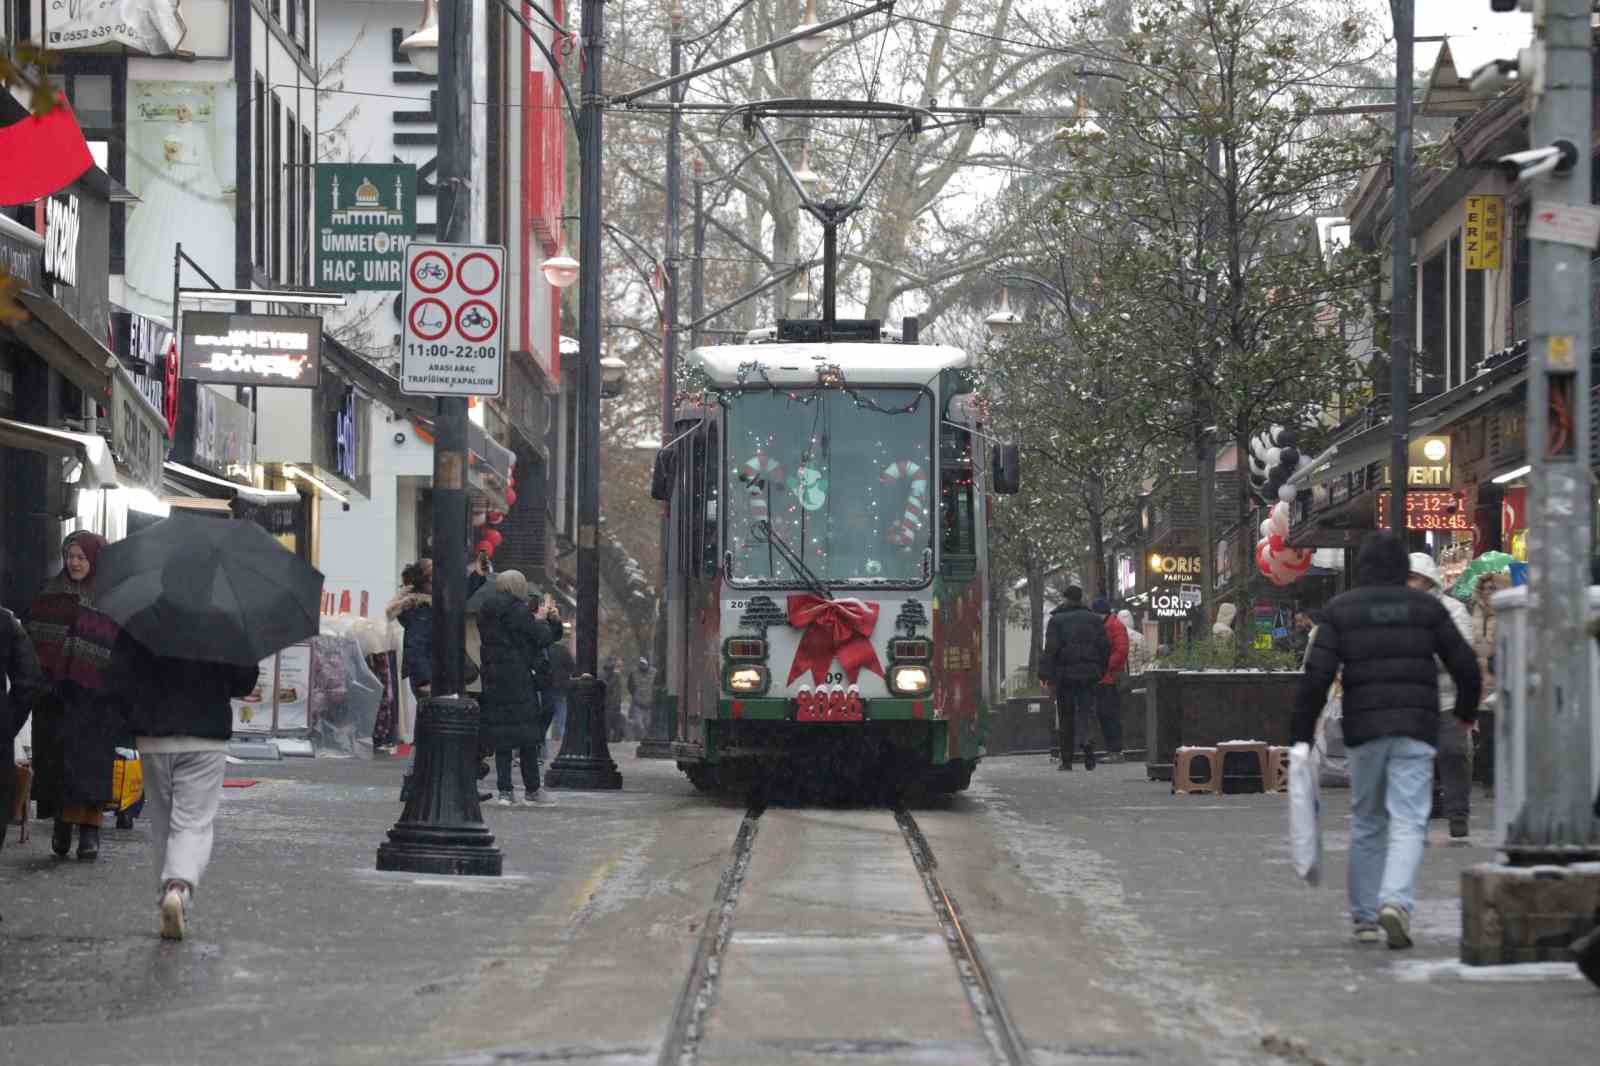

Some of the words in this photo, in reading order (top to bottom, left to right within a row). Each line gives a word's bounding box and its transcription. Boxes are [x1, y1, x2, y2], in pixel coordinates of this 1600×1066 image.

[408, 343, 496, 359] 11:00-22:00
[454, 365, 476, 374] ARAÇ
[1384, 466, 1444, 485] LENT
[1406, 497, 1465, 511] 5-12-1
[1406, 514, 1466, 528] 1:30:45
[1164, 574, 1193, 582] PARFUM
[1152, 595, 1192, 609] LORIS
[1157, 608, 1188, 617] PARFUM
